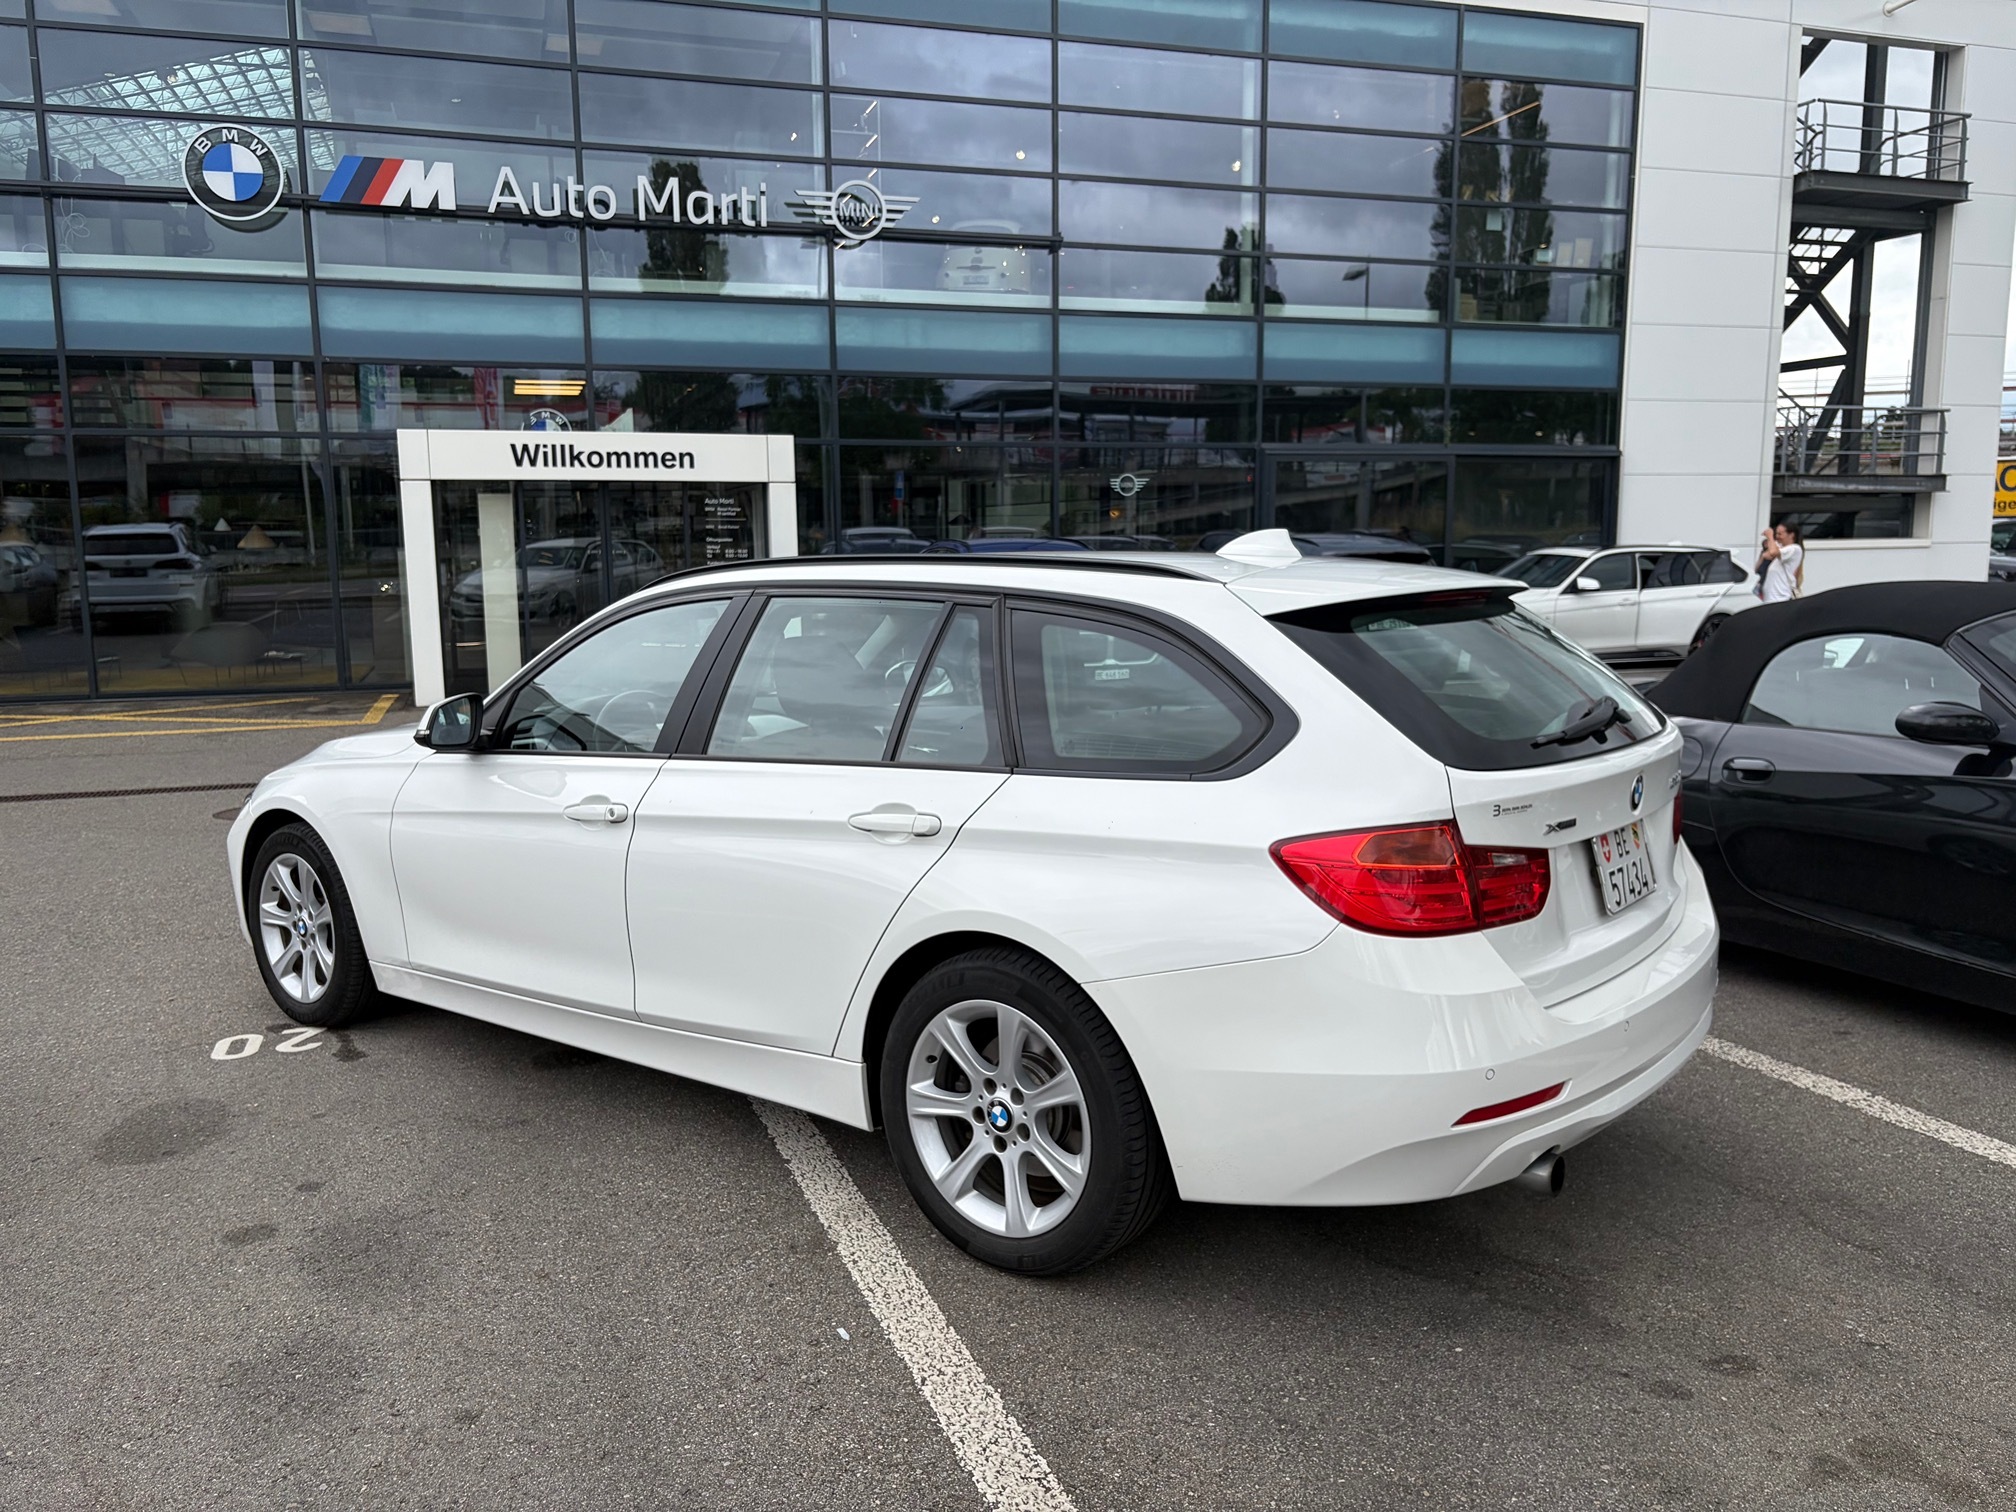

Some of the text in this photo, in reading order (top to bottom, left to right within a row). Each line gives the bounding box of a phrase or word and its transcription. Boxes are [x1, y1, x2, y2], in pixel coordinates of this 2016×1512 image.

[380, 159, 457, 211] M
[488, 166, 768, 228] Auto Marti
[839, 201, 878, 218] MINI
[510, 443, 696, 470] Willkommen
[1614, 828, 1630, 858] BE
[1608, 858, 1649, 907] 57434
